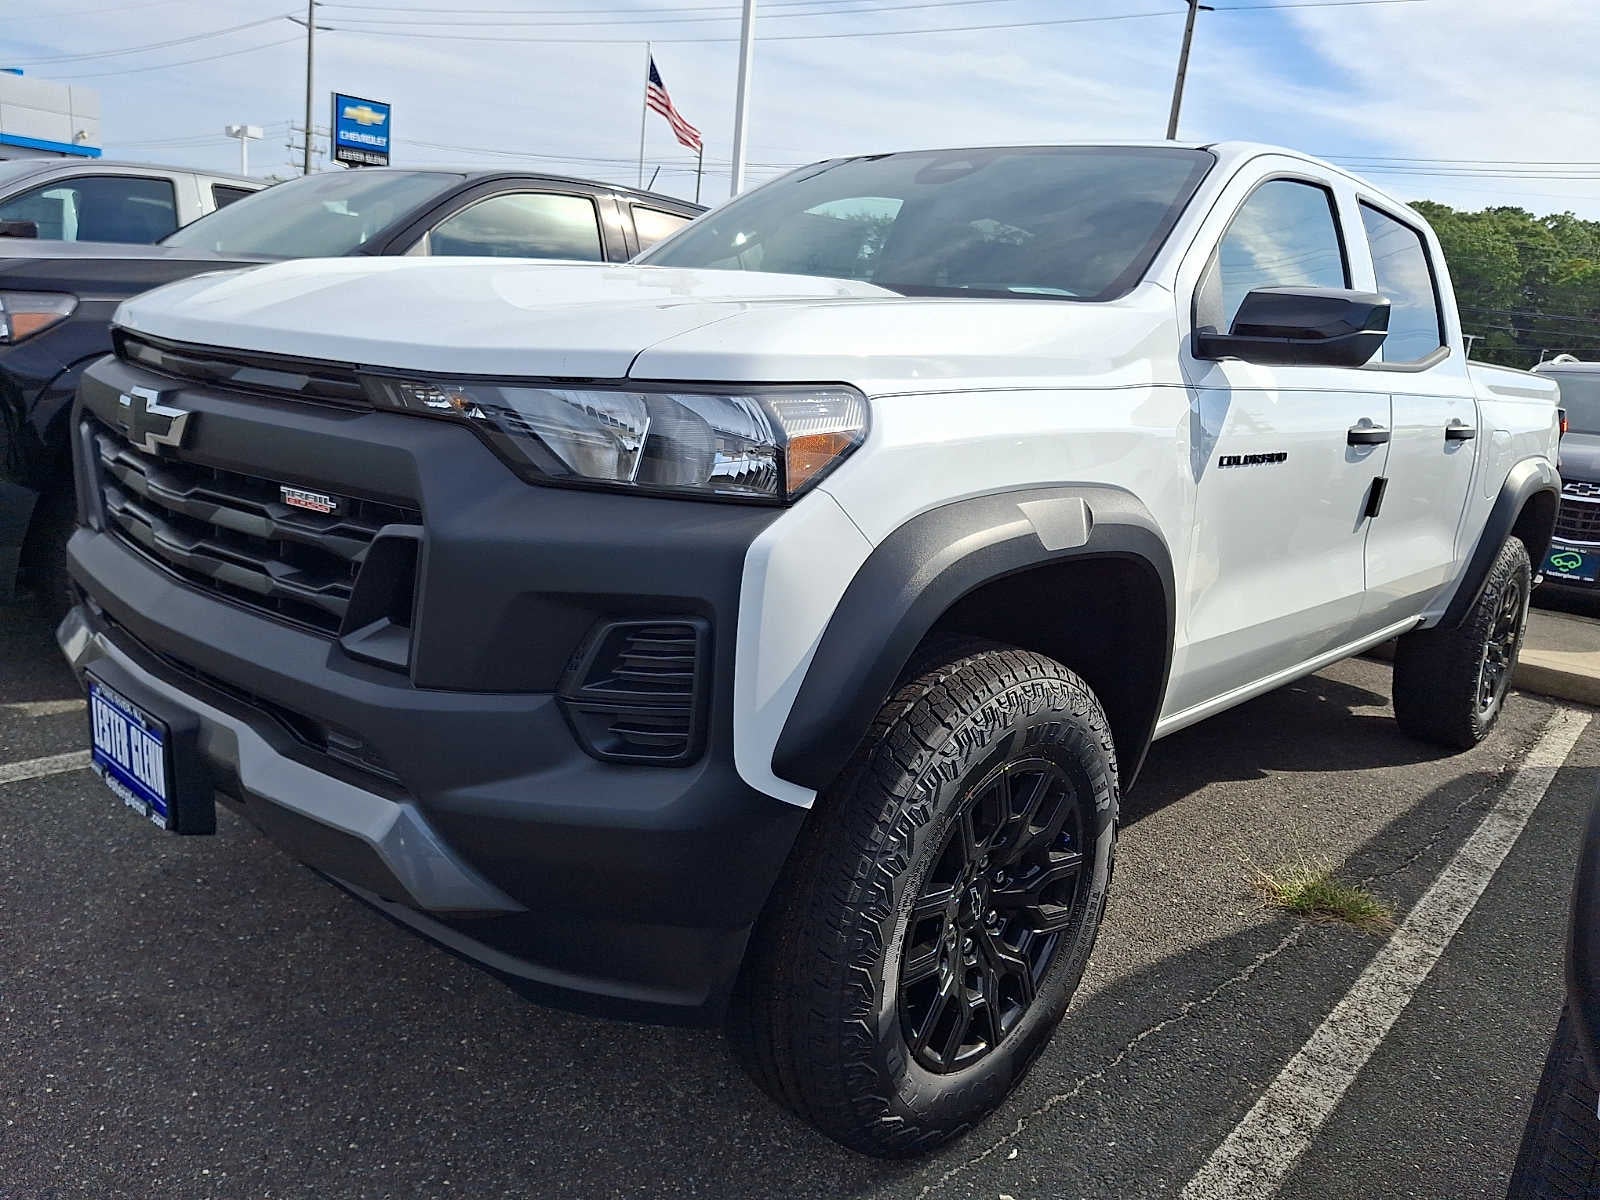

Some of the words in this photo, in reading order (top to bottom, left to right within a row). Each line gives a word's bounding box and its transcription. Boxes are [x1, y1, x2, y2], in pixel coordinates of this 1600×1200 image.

[1219, 452, 1288, 467] COLORADO
[280, 486, 336, 509] TRAIL
[91, 696, 131, 770] LESTER
[130, 724, 166, 800] GLENN
